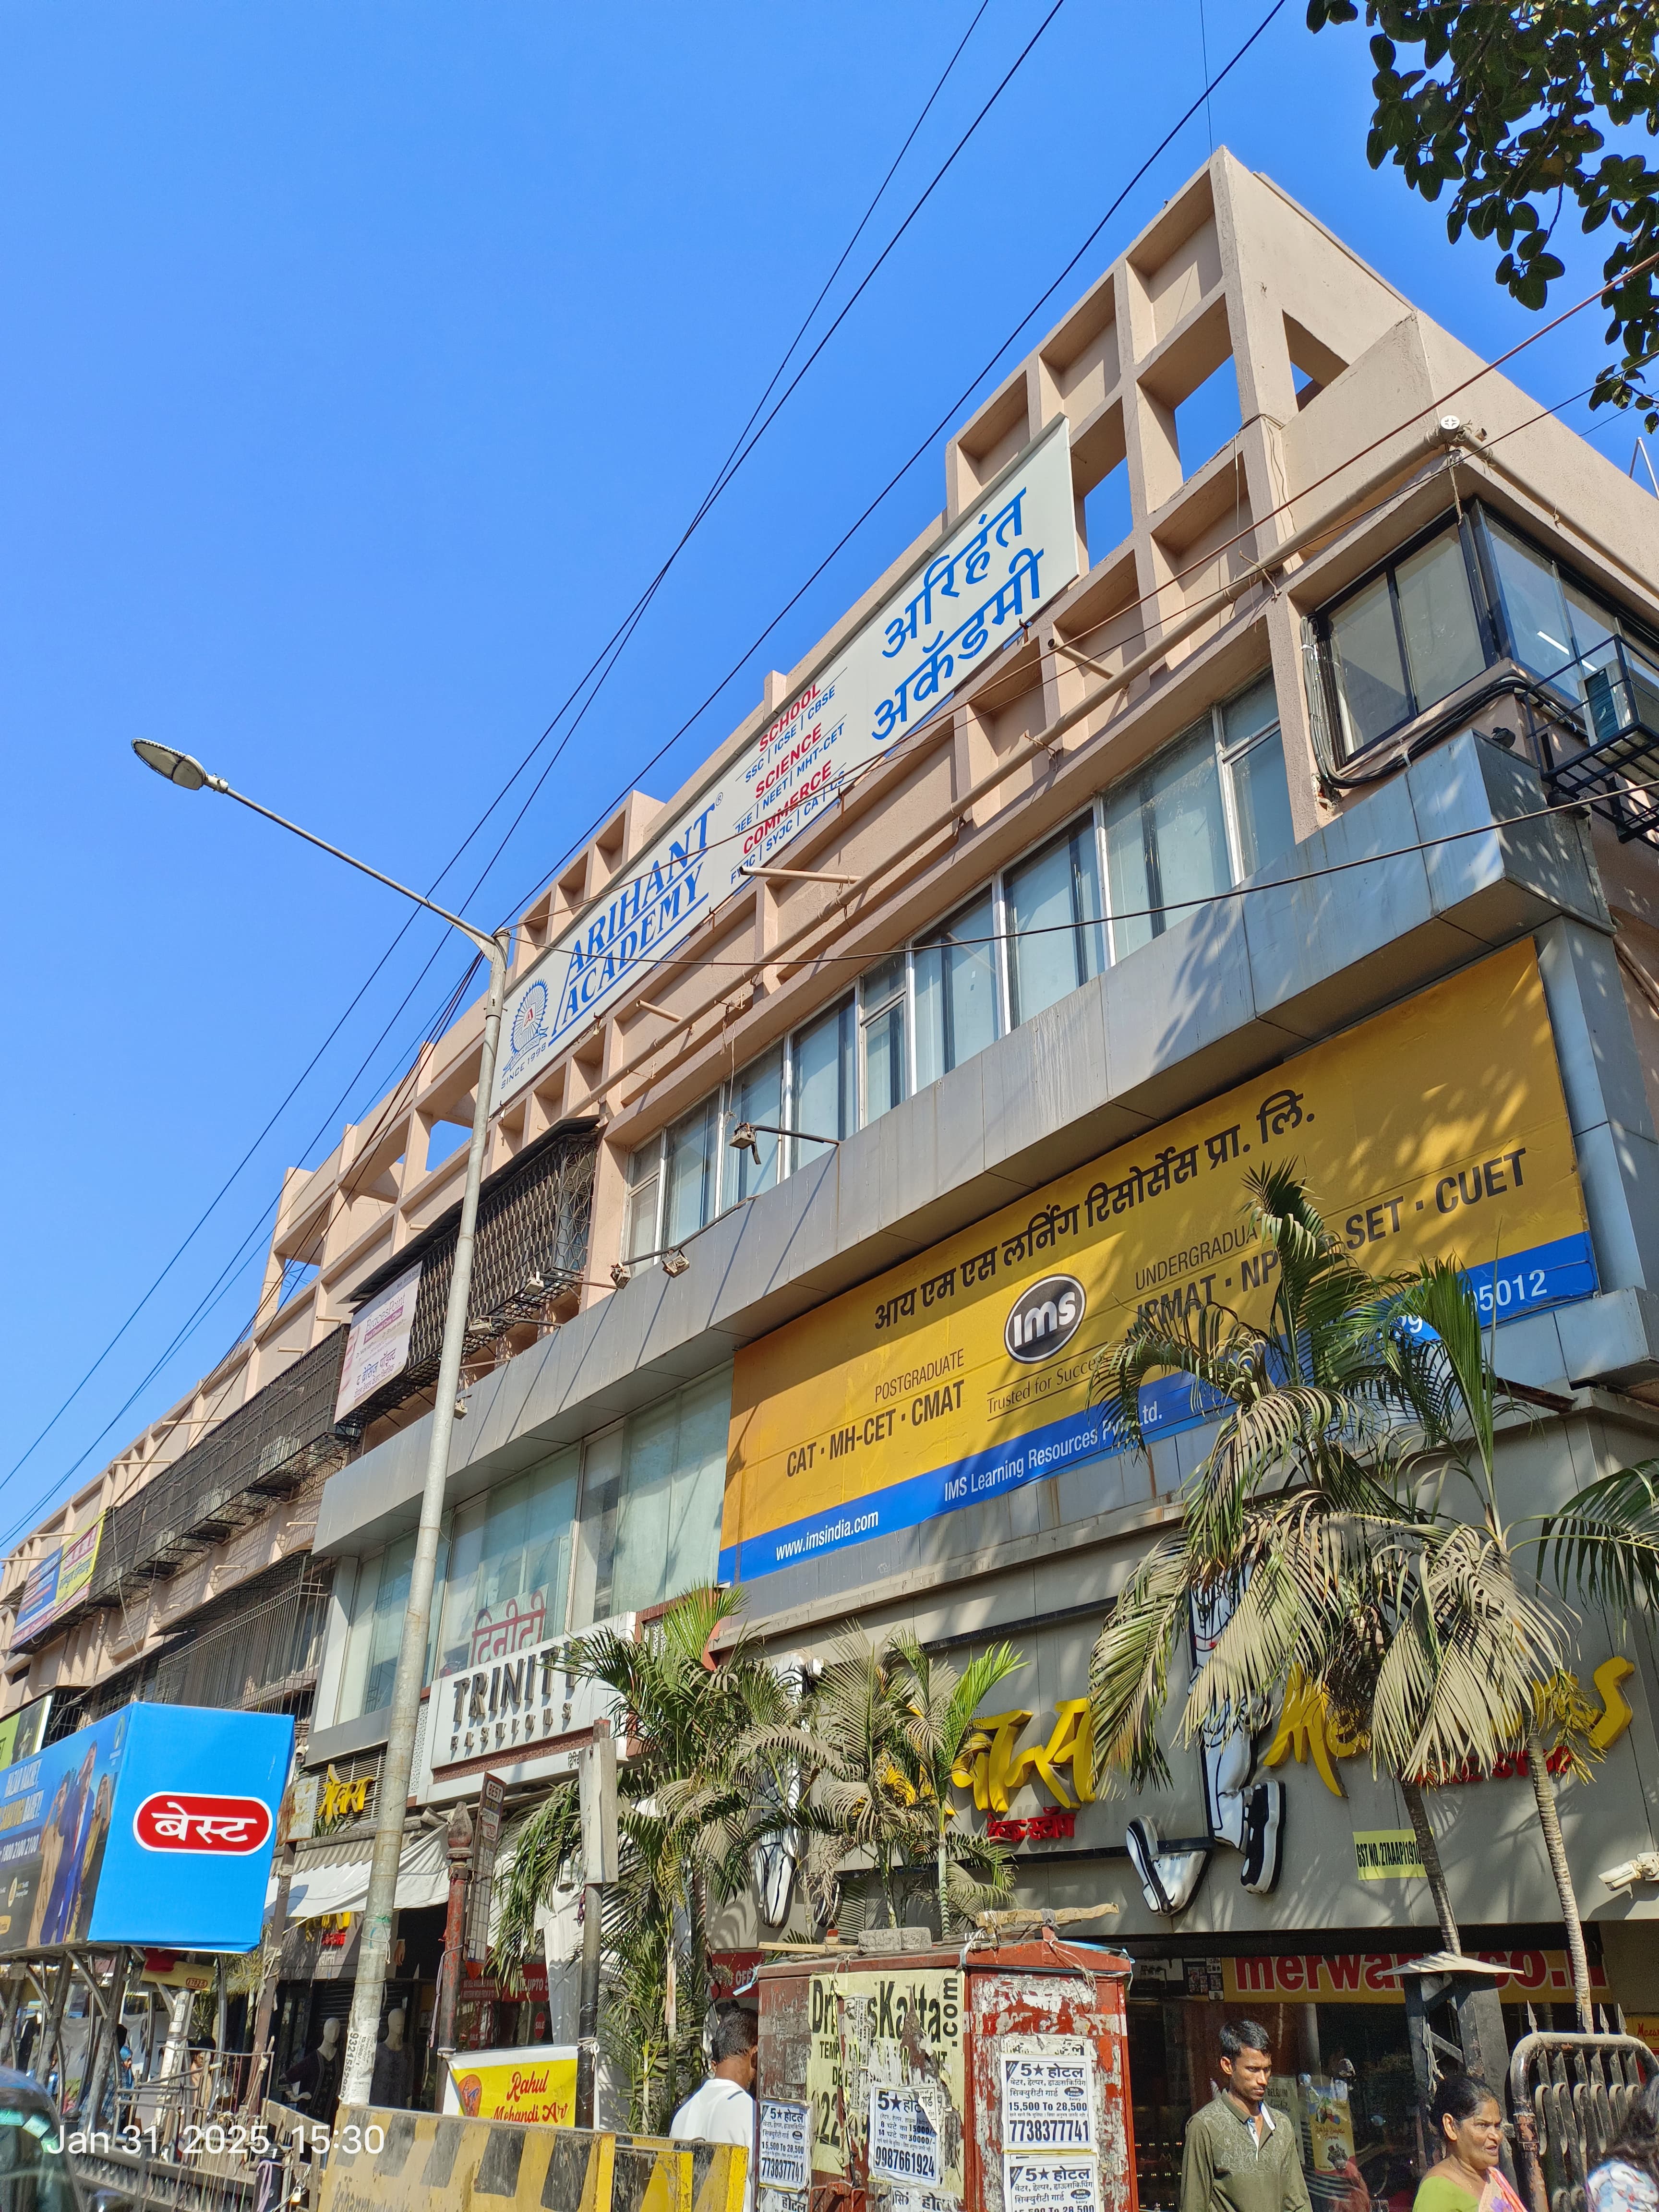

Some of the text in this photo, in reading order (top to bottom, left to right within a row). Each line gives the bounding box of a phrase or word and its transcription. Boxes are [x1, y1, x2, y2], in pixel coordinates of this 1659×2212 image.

[882, 487, 1026, 658] अरिहंत
[871, 548, 1044, 740] अकॅडमी
[745, 685, 835, 783] SSC ICSE CBSE
[759, 683, 820, 752] SCHOOL
[735, 722, 844, 835] JEE NEET MHT-CET
[755, 722, 821, 799] SCIENCE
[743, 759, 832, 855] COMMERCE
[766, 819, 793, 852] SYJC
[804, 794, 819, 817] CA
[567, 803, 716, 974] ARIHANT
[562, 862, 704, 1026] ACADEMY
[501, 1042, 546, 1089] SINCE 1998
[875, 1089, 1315, 1329] आय एम एस लर्निंग रिसोर्सेस प्रा. लि.
[1241, 1249, 1284, 1292] NP
[1346, 1196, 1404, 1250] SET
[1436, 1147, 1526, 1214] CUET
[1136, 1217, 1273, 1290] UNDERGRADUA
[875, 1348, 964, 1403] POSTGRADUATE
[987, 1380, 1031, 1414] Trusted
[1034, 1376, 1052, 1395] for
[787, 1379, 964, 1478] CAT MH-CET CMAT
[944, 1476, 967, 1502] IMS
[971, 1457, 1024, 1493] Learning
[1028, 1428, 1098, 1469] Resources
[776, 1511, 879, 1561] www.imsindia.com
[450, 1703, 572, 1751] FASHIONS
[488, 1784, 501, 1801] BEST
[151, 1802, 257, 1844] बेस्ट
[1356, 1843, 1369, 1867] GST
[1369, 1843, 1380, 1866] NO.
[528, 1978, 543, 1991] UPTO
[943, 1978, 958, 2047] .com
[506, 2069, 550, 2102] Rahul
[1045, 2088, 1058, 2096] गार्ड
[1046, 2063, 1084, 2079] होटल
[492, 2102, 568, 2123] Mehandi Art
[784, 2109, 804, 2123] होटल
[903, 2094, 925, 2113] होट
[1009, 2102, 1087, 2111] 15,500 To 28,500
[887, 2122, 897, 2130] घंटे
[1010, 2120, 1089, 2141] 7738377741
[762, 2157, 803, 2182] 7738377741
[787, 2144, 804, 2154] 28,500
[876, 2146, 934, 2177] 9987661924
[1052, 2165, 1091, 2182] होटल
[782, 2194, 806, 2212] होटल
[921, 2191, 954, 2212] होट
[1051, 2191, 1065, 2201] गार्ड
